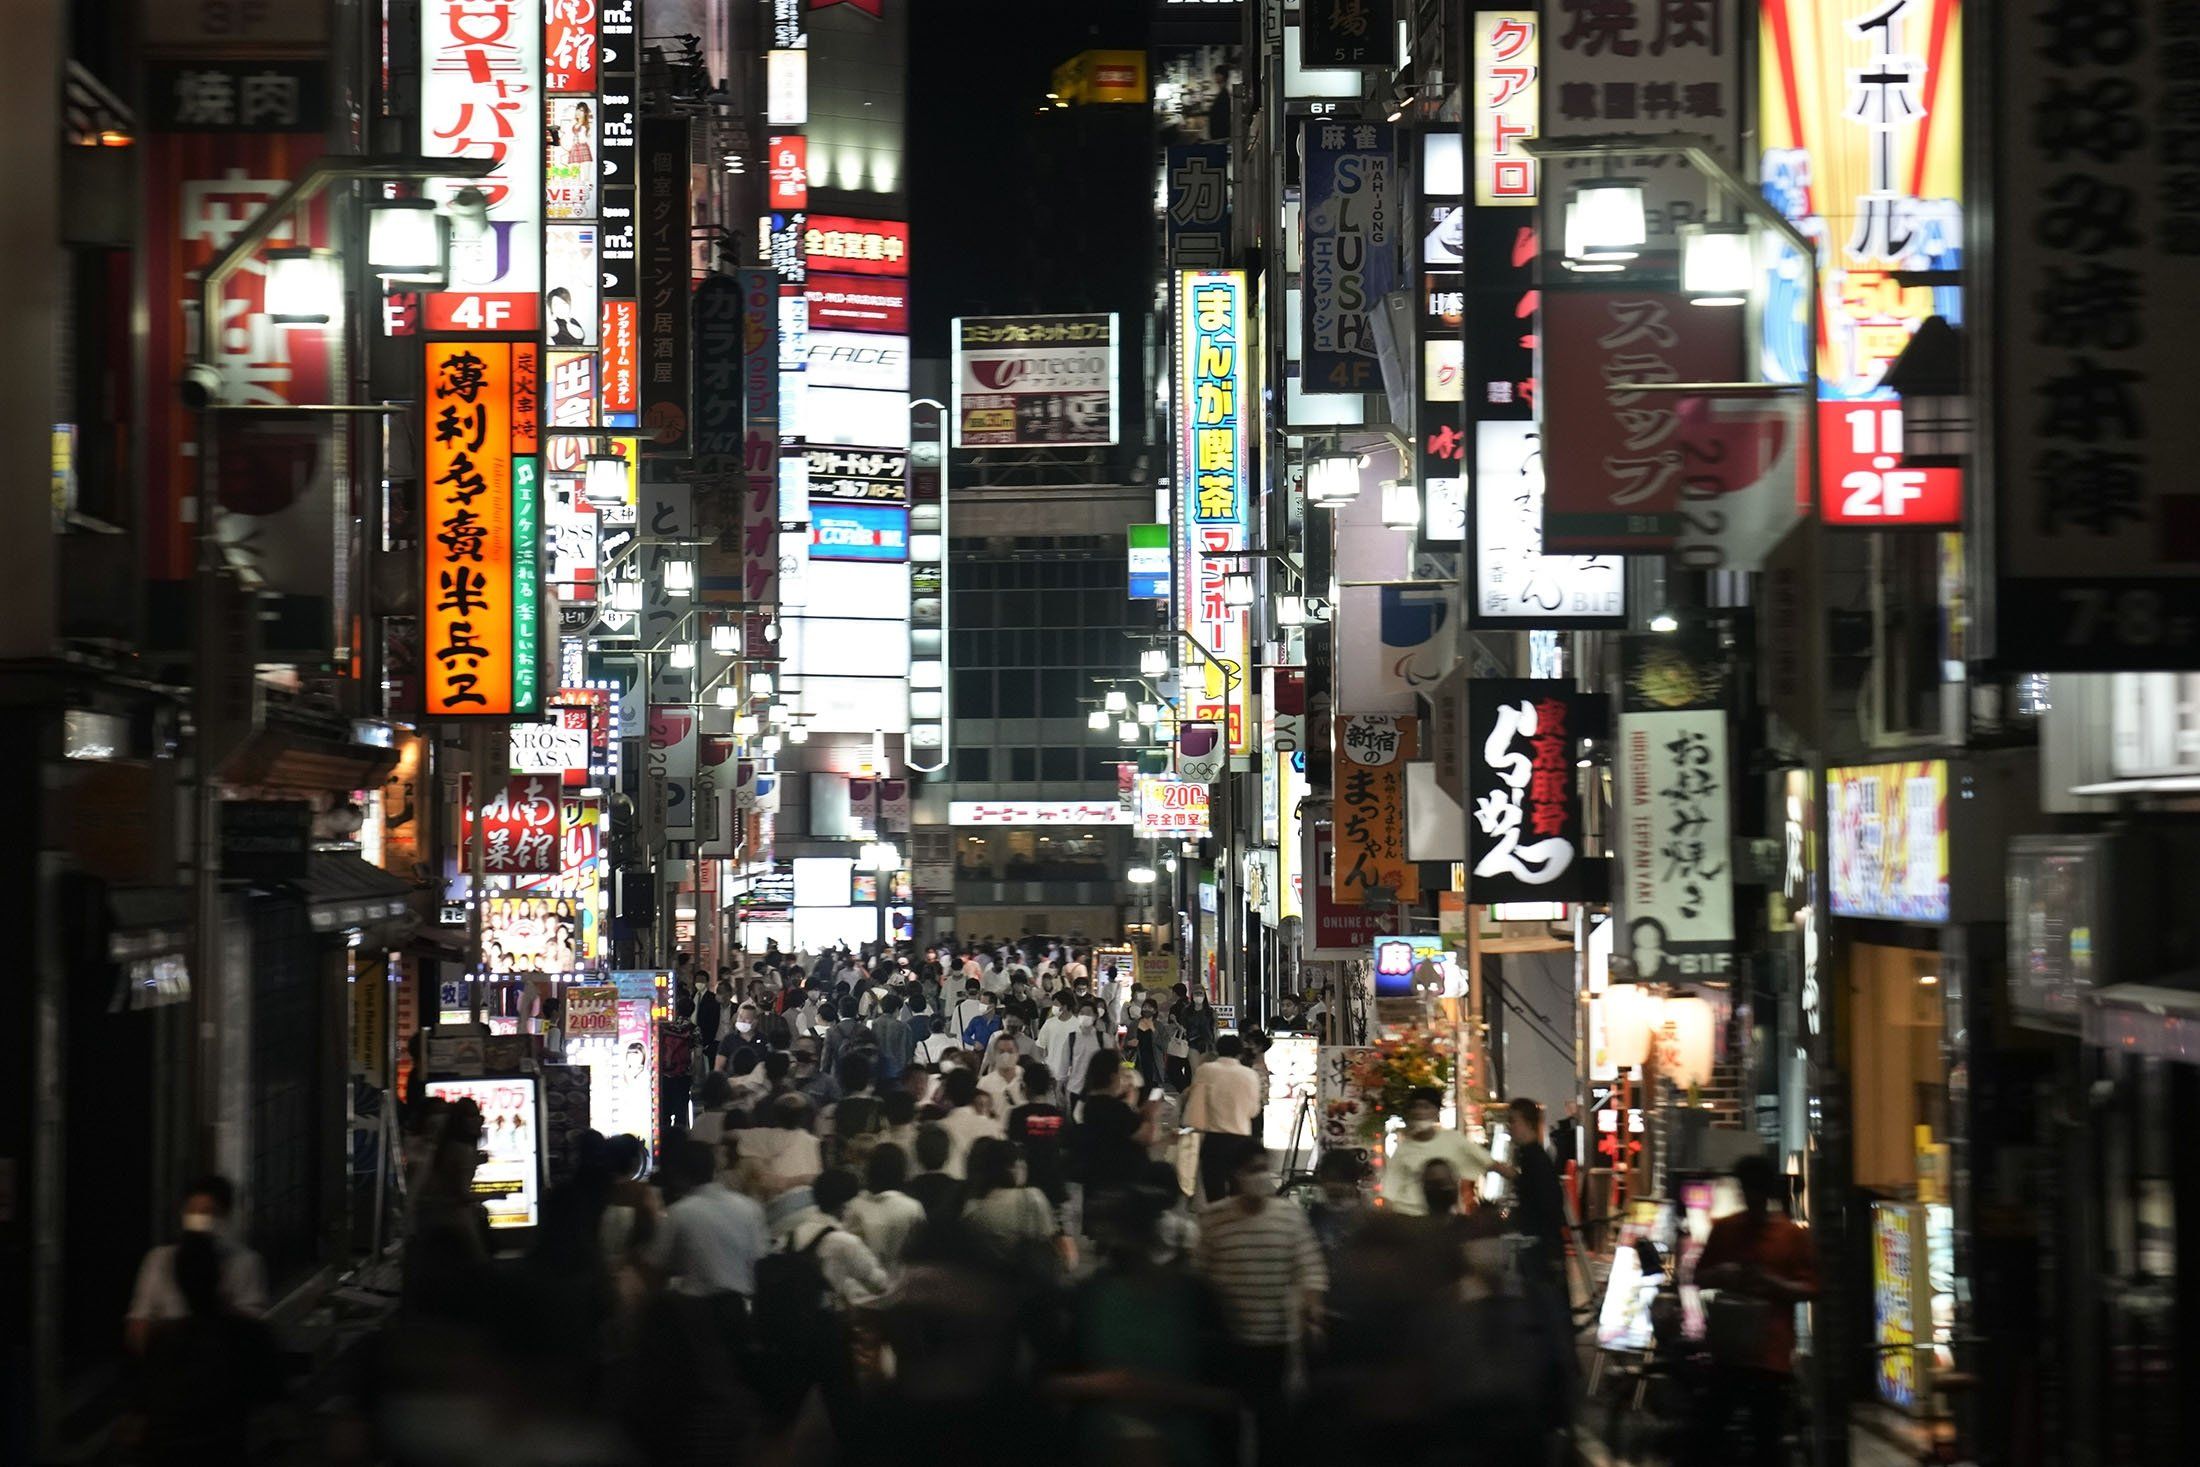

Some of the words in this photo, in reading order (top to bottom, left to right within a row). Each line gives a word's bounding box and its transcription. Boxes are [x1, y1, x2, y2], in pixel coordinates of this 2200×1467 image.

[173, 69, 299, 125] 焼肉
[1310, 102, 1336, 114] 6F
[1489, 18, 1537, 198] クアトロ
[1320, 125, 1378, 150] 麻雀
[652, 151, 674, 385] 個室ダイニング居酒屋
[1315, 242, 1334, 348] エスラッシュ
[450, 296, 512, 329] 4F
[702, 287, 738, 428] カラオケ
[807, 344, 904, 366] FACE
[1328, 361, 1372, 388] 4F
[1195, 282, 1240, 522] まんが喫茶
[1841, 471, 1926, 516] 2F
[743, 431, 774, 601] カラオケ
[608, 613, 625, 623] B1
[510, 732, 582, 750] XROSS
[650, 724, 668, 778] 2020
[1346, 725, 1398, 751] 新宿
[515, 750, 574, 768] CASA
[1363, 750, 1381, 764] の
[1146, 813, 1200, 826] 完全個室
[1343, 769, 1381, 889] まっちゃん
[1322, 915, 1361, 930] ONLINE
[1678, 952, 1734, 974] B1F
